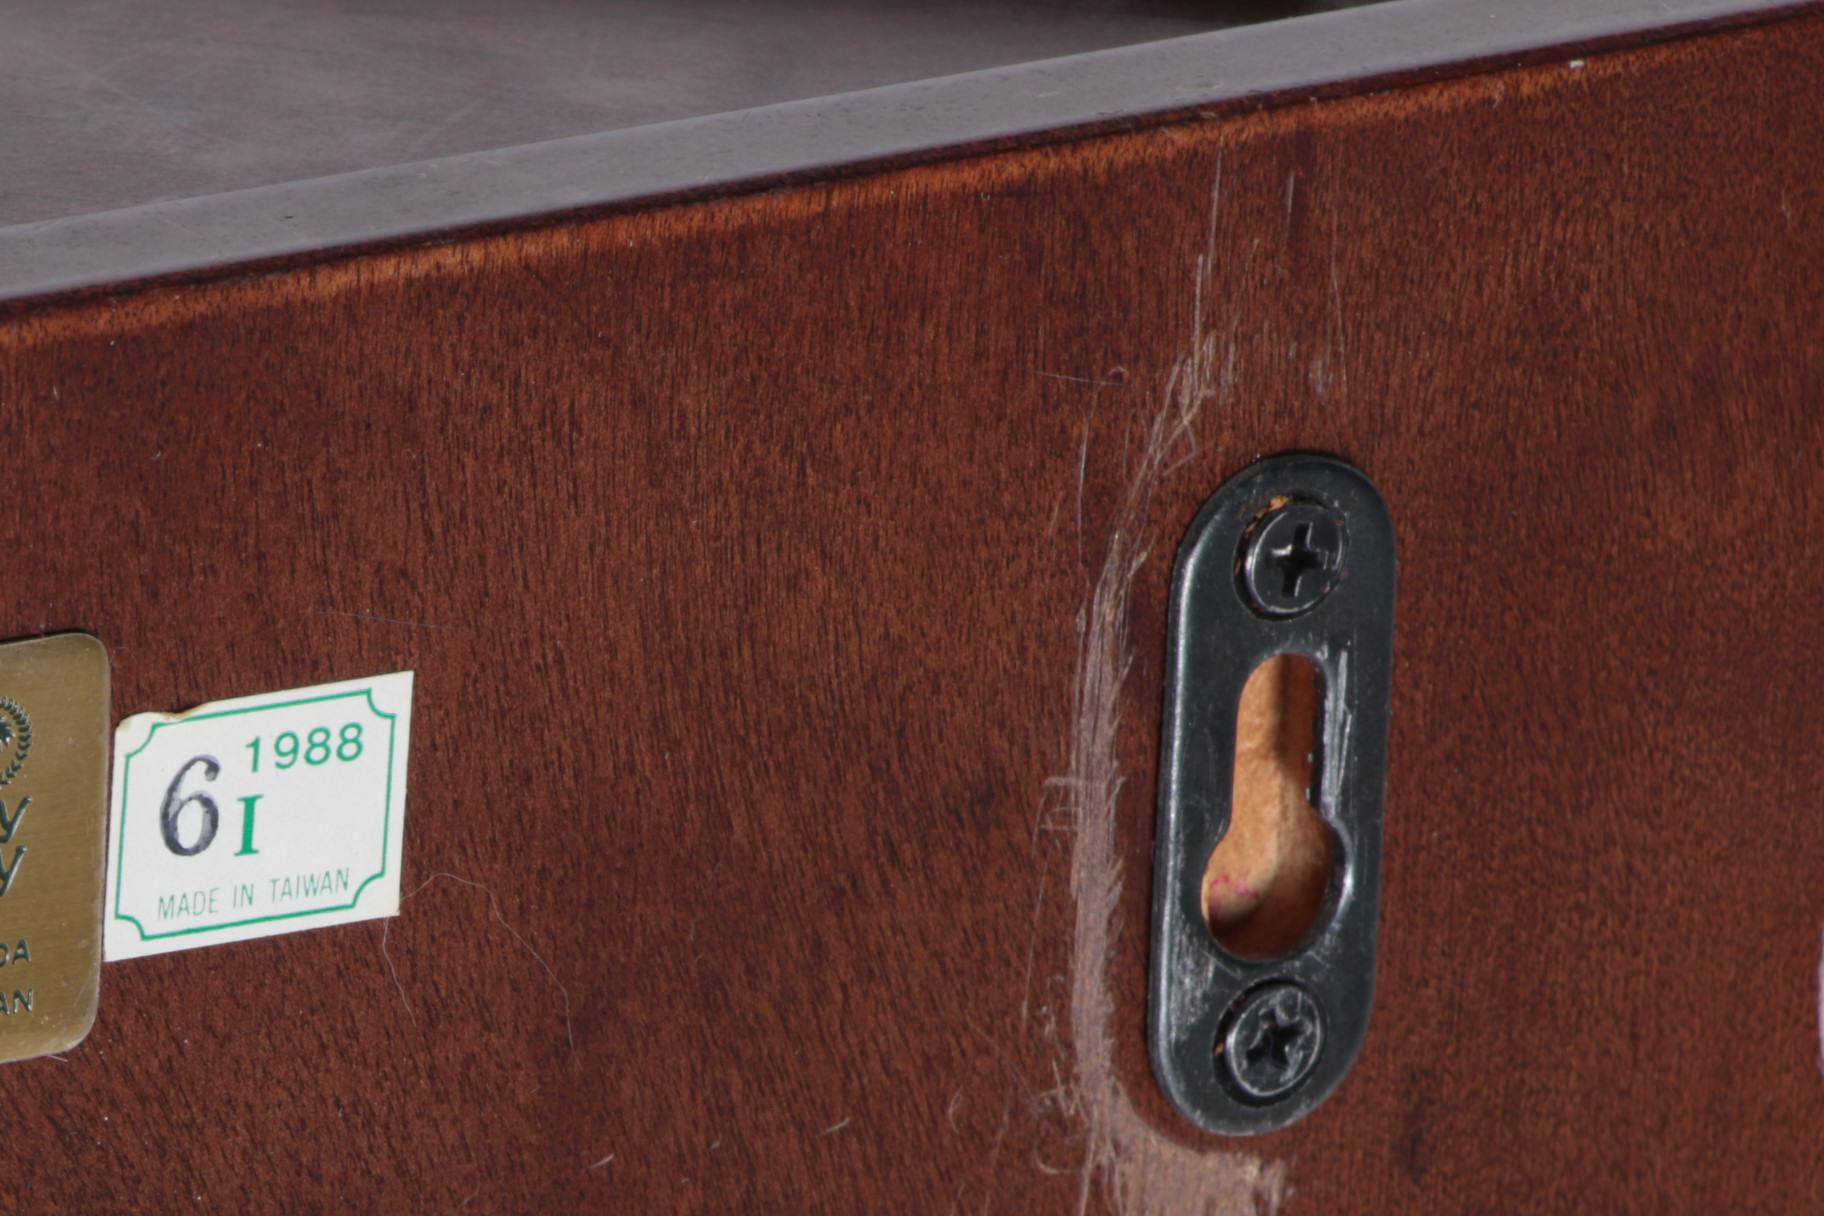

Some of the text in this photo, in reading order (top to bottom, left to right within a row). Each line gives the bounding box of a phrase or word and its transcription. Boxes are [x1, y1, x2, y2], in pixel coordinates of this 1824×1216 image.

[245, 721, 364, 773] 1988
[159, 754, 221, 856] 6
[157, 867, 350, 921] MADE IN TAIWAN
